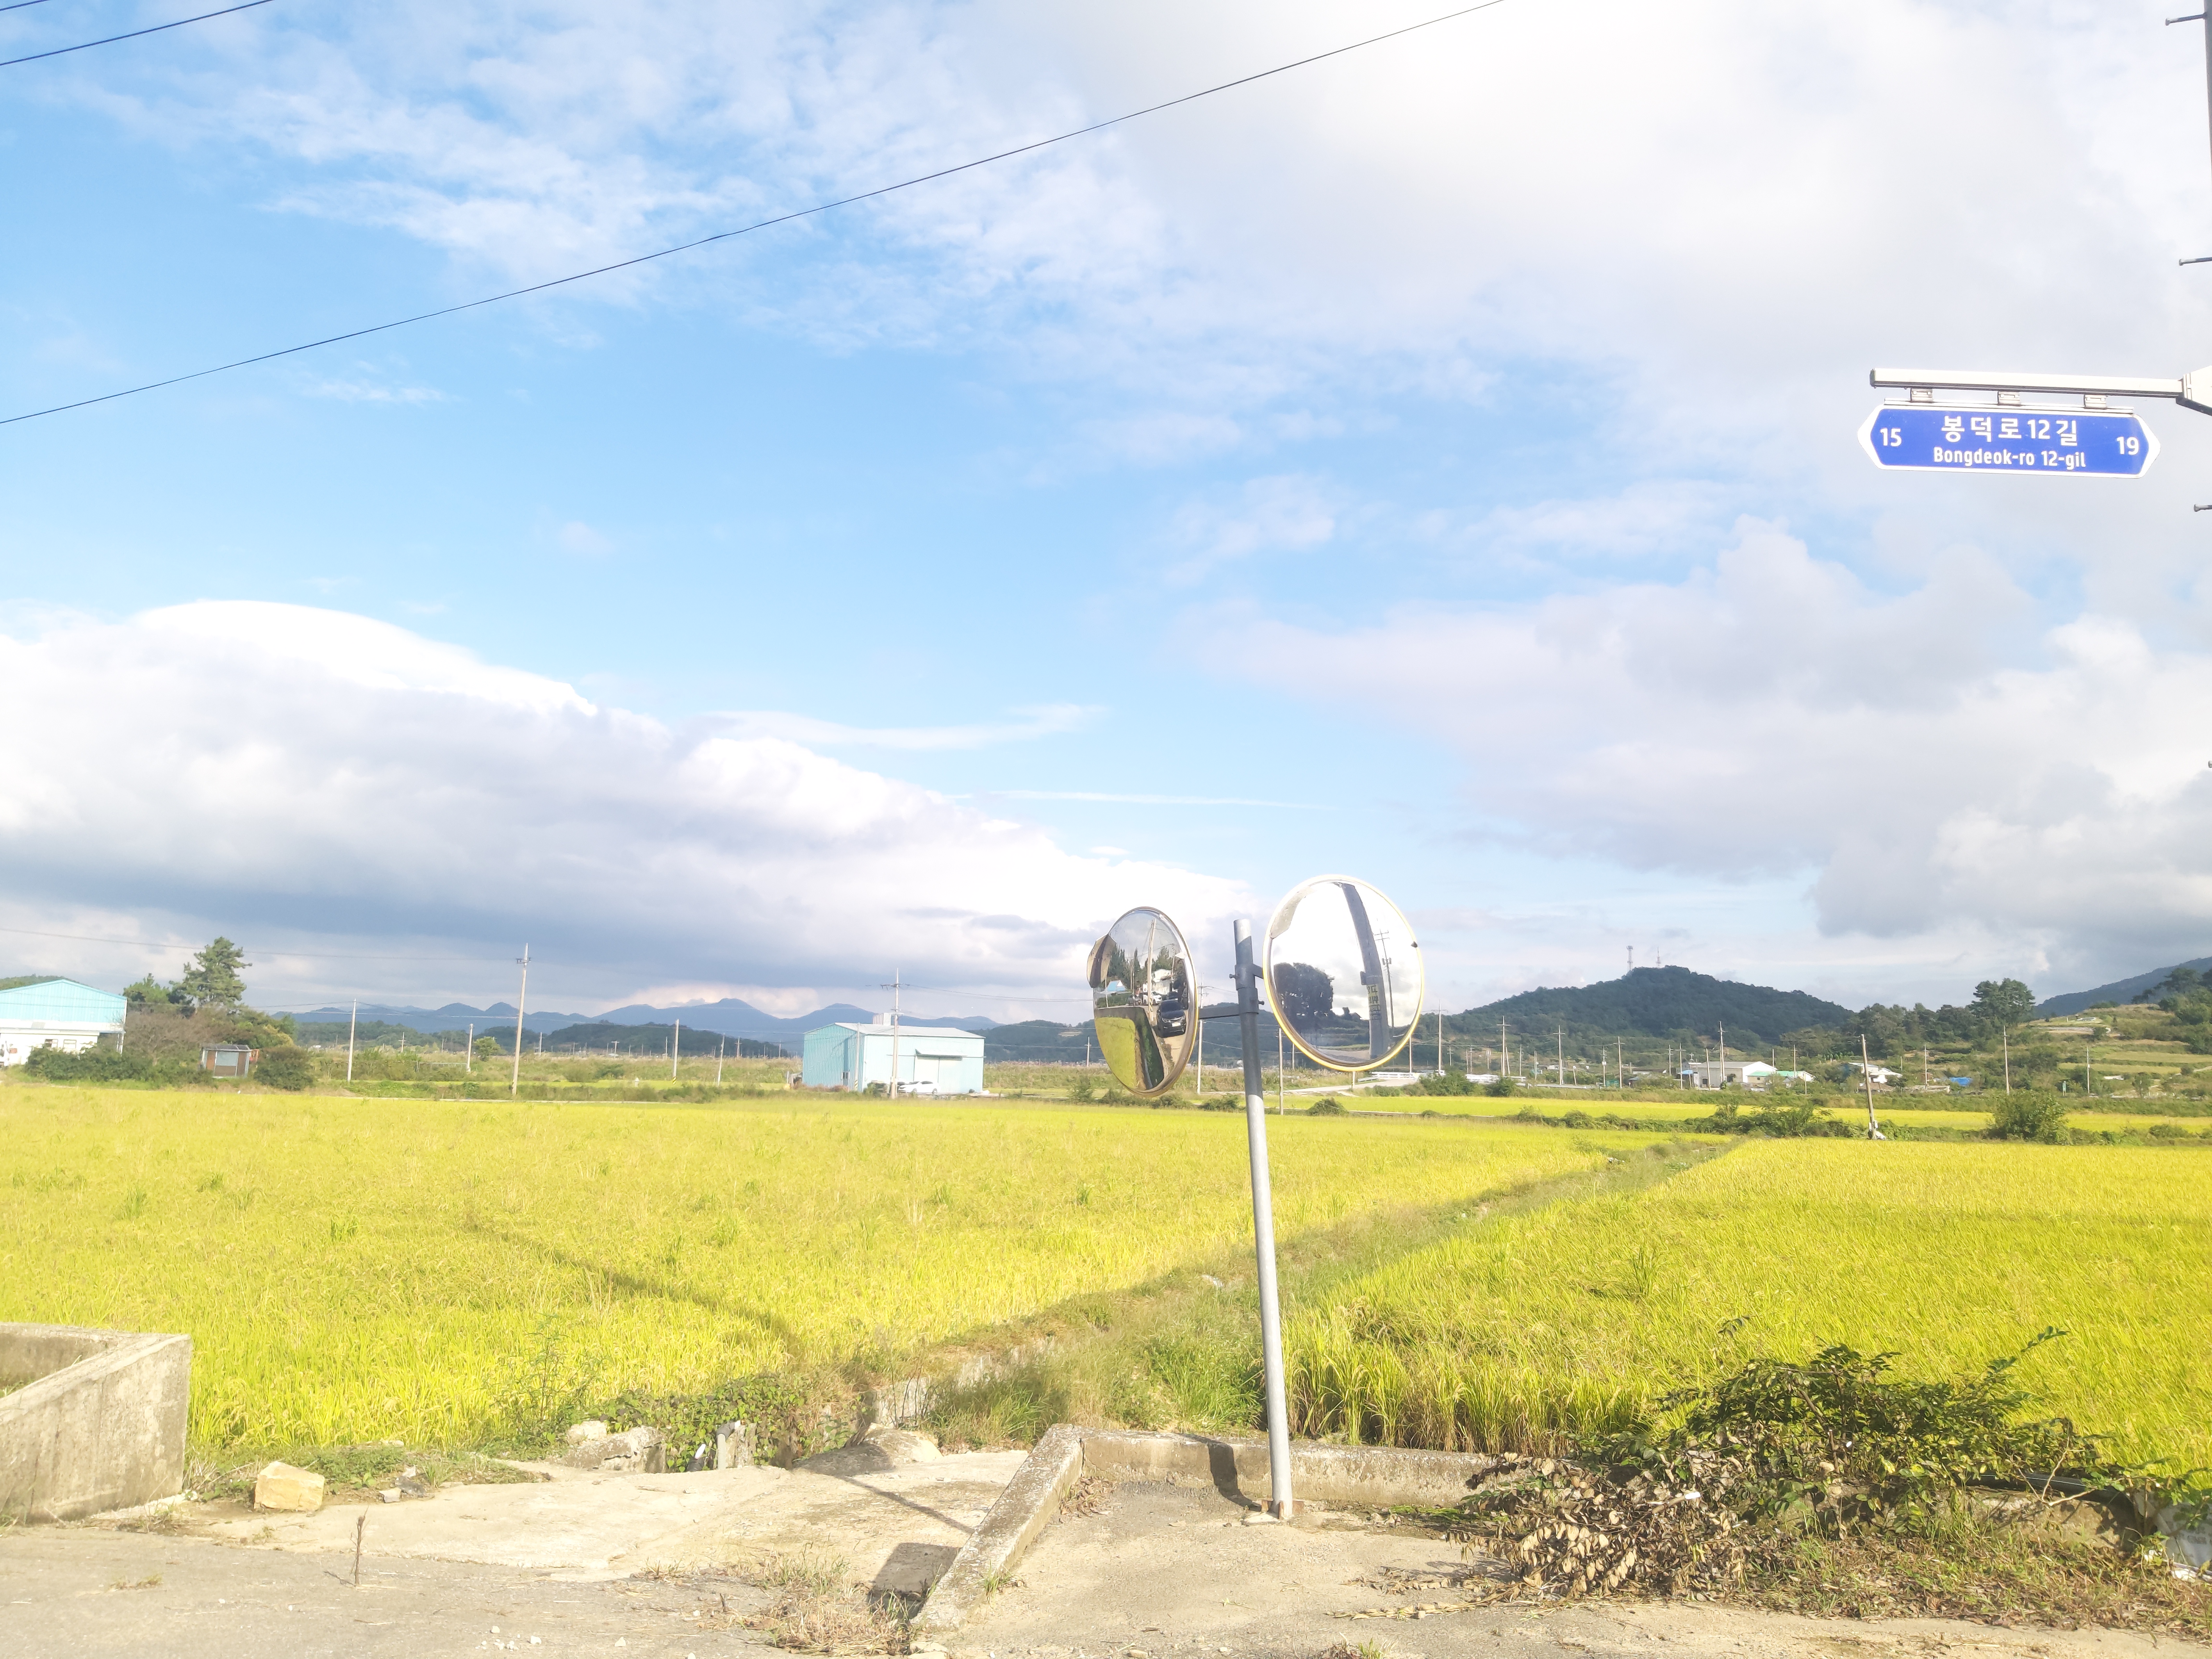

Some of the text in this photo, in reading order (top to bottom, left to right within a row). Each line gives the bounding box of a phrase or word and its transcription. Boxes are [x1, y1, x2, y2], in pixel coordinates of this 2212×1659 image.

[1880, 427, 1902, 447] 15
[1941, 414, 2078, 446] 봉덕로12길
[2116, 436, 2140, 455] 19
[1933, 446, 2086, 470] Bongdeok-ro 12-gil
